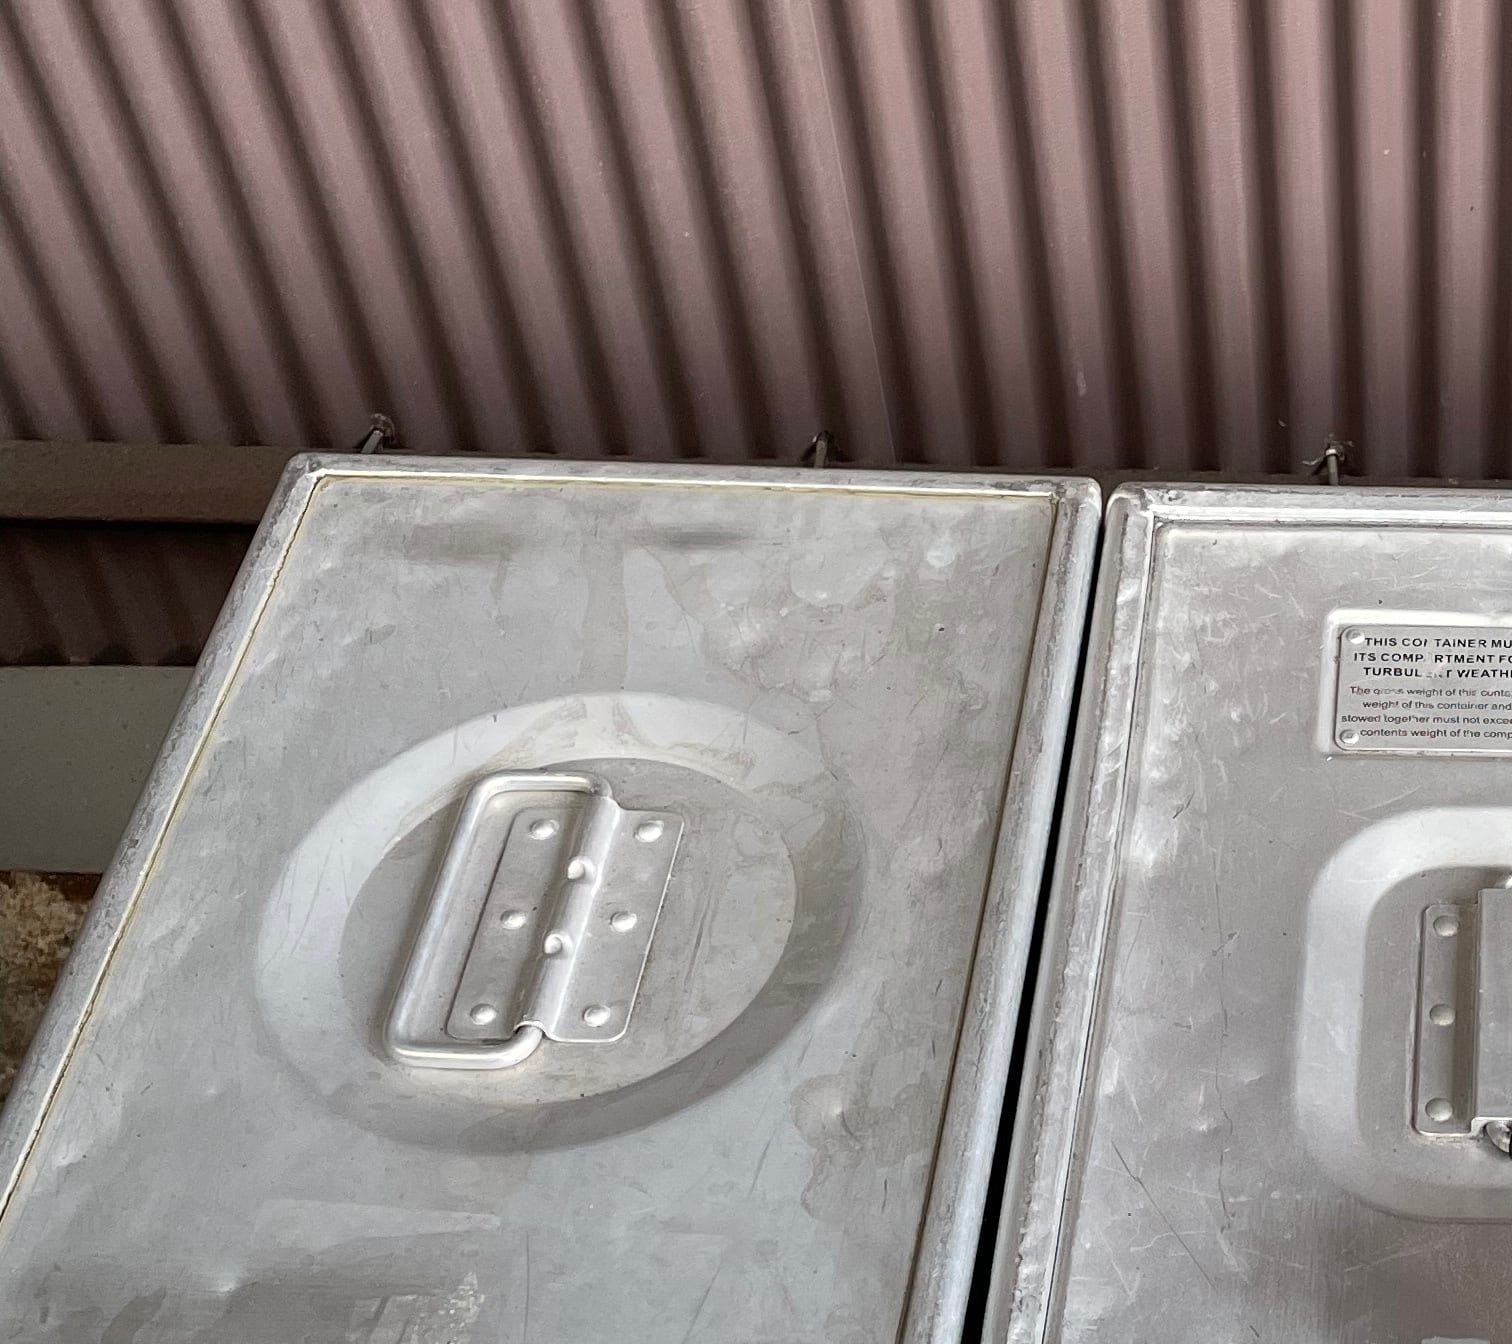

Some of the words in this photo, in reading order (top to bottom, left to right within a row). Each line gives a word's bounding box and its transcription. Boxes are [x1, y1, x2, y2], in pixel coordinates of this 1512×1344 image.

[1365, 637, 1398, 647] THIS
[1401, 638, 1487, 648] COTAINER
[1354, 652, 1377, 662] ITS
[1380, 653, 1495, 663] COMPRTMENT
[1350, 686, 1371, 695] The
[1406, 687, 1443, 698] weight
[1445, 687, 1456, 697] of
[1363, 700, 1398, 710] weight
[1401, 700, 1412, 709] of
[1415, 700, 1434, 709] this
[1437, 701, 1489, 711] container
[1491, 702, 1512, 711] and
[1341, 714, 1381, 724] stowed
[1433, 715, 1460, 724] must
[1462, 715, 1480, 724] not
[1360, 728, 1408, 738] contents
[1411, 729, 1447, 739] weight
[1449, 728, 1460, 738] of
[1463, 729, 1480, 738] the
